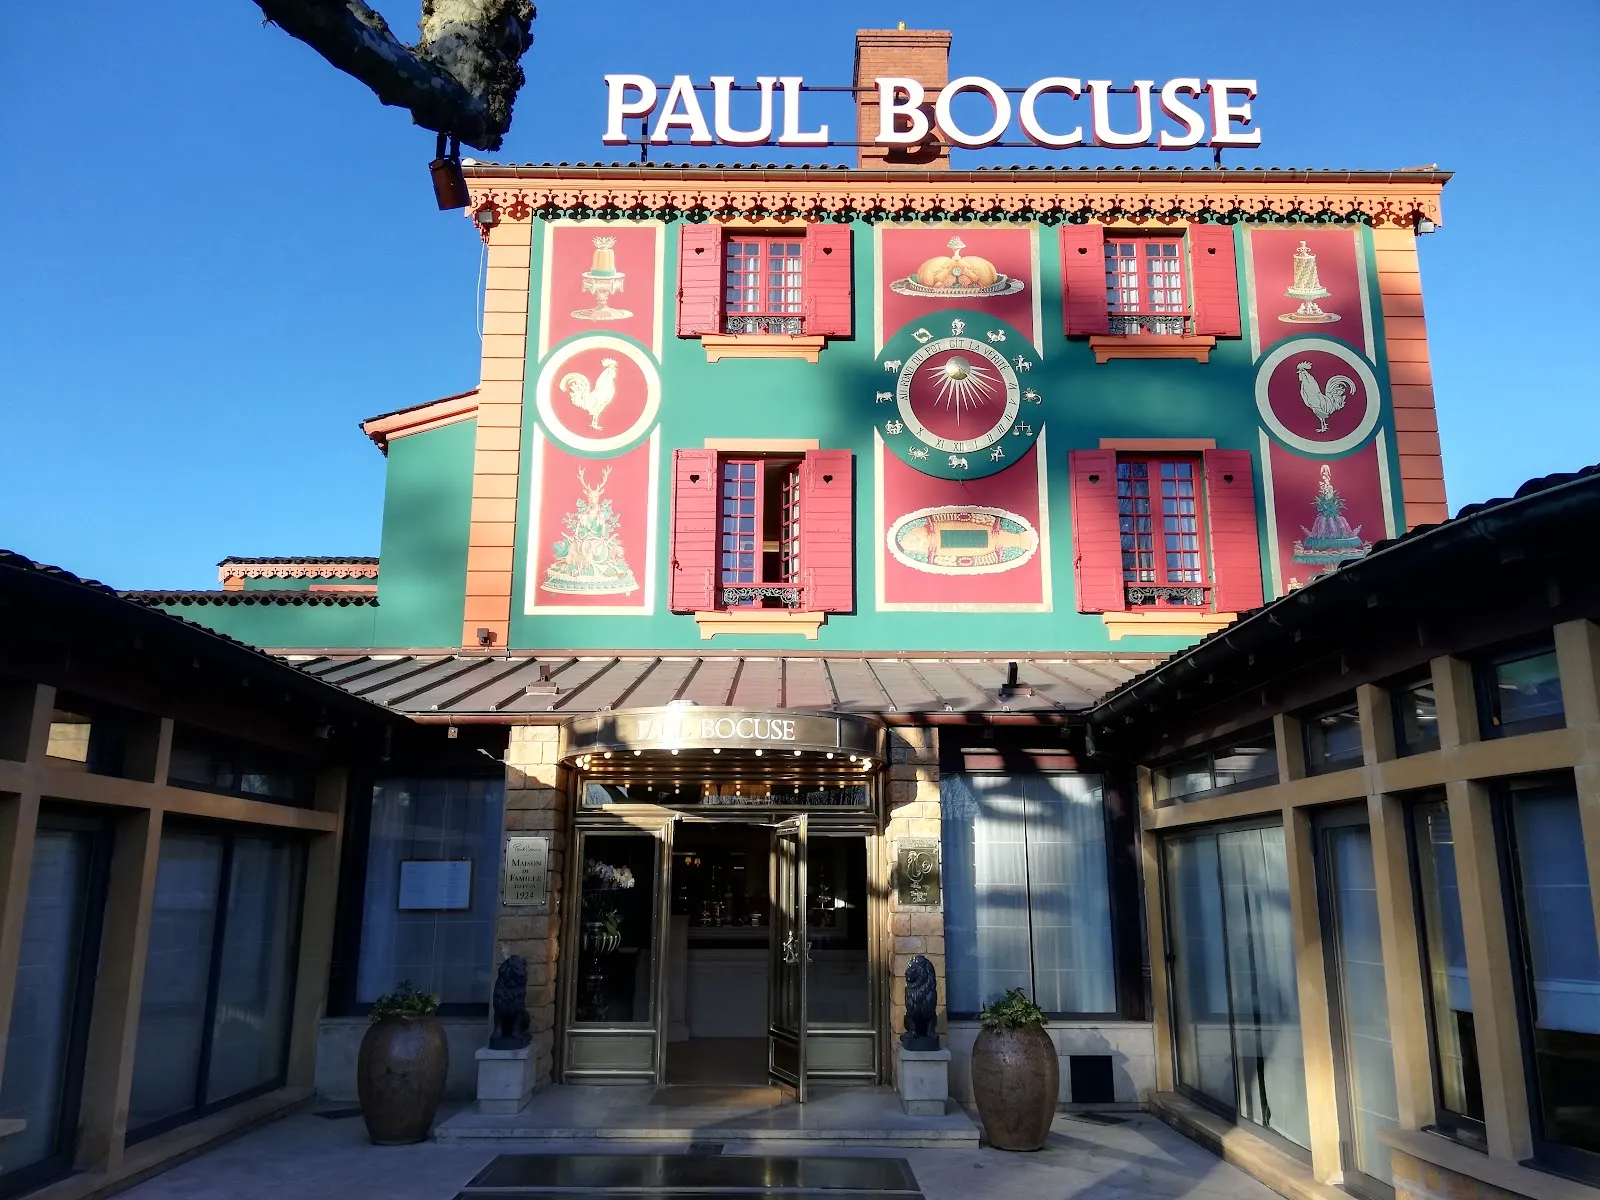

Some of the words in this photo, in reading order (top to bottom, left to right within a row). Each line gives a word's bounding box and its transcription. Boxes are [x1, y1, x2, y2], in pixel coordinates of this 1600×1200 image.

[602, 74, 829, 147] PAUL
[873, 76, 1262, 151] BOCUSE
[911, 352, 924, 366] DU
[925, 342, 941, 356] POT
[636, 718, 692, 740] PAL
[700, 717, 796, 741] BOCUSE
[515, 891, 534, 900] 1924
